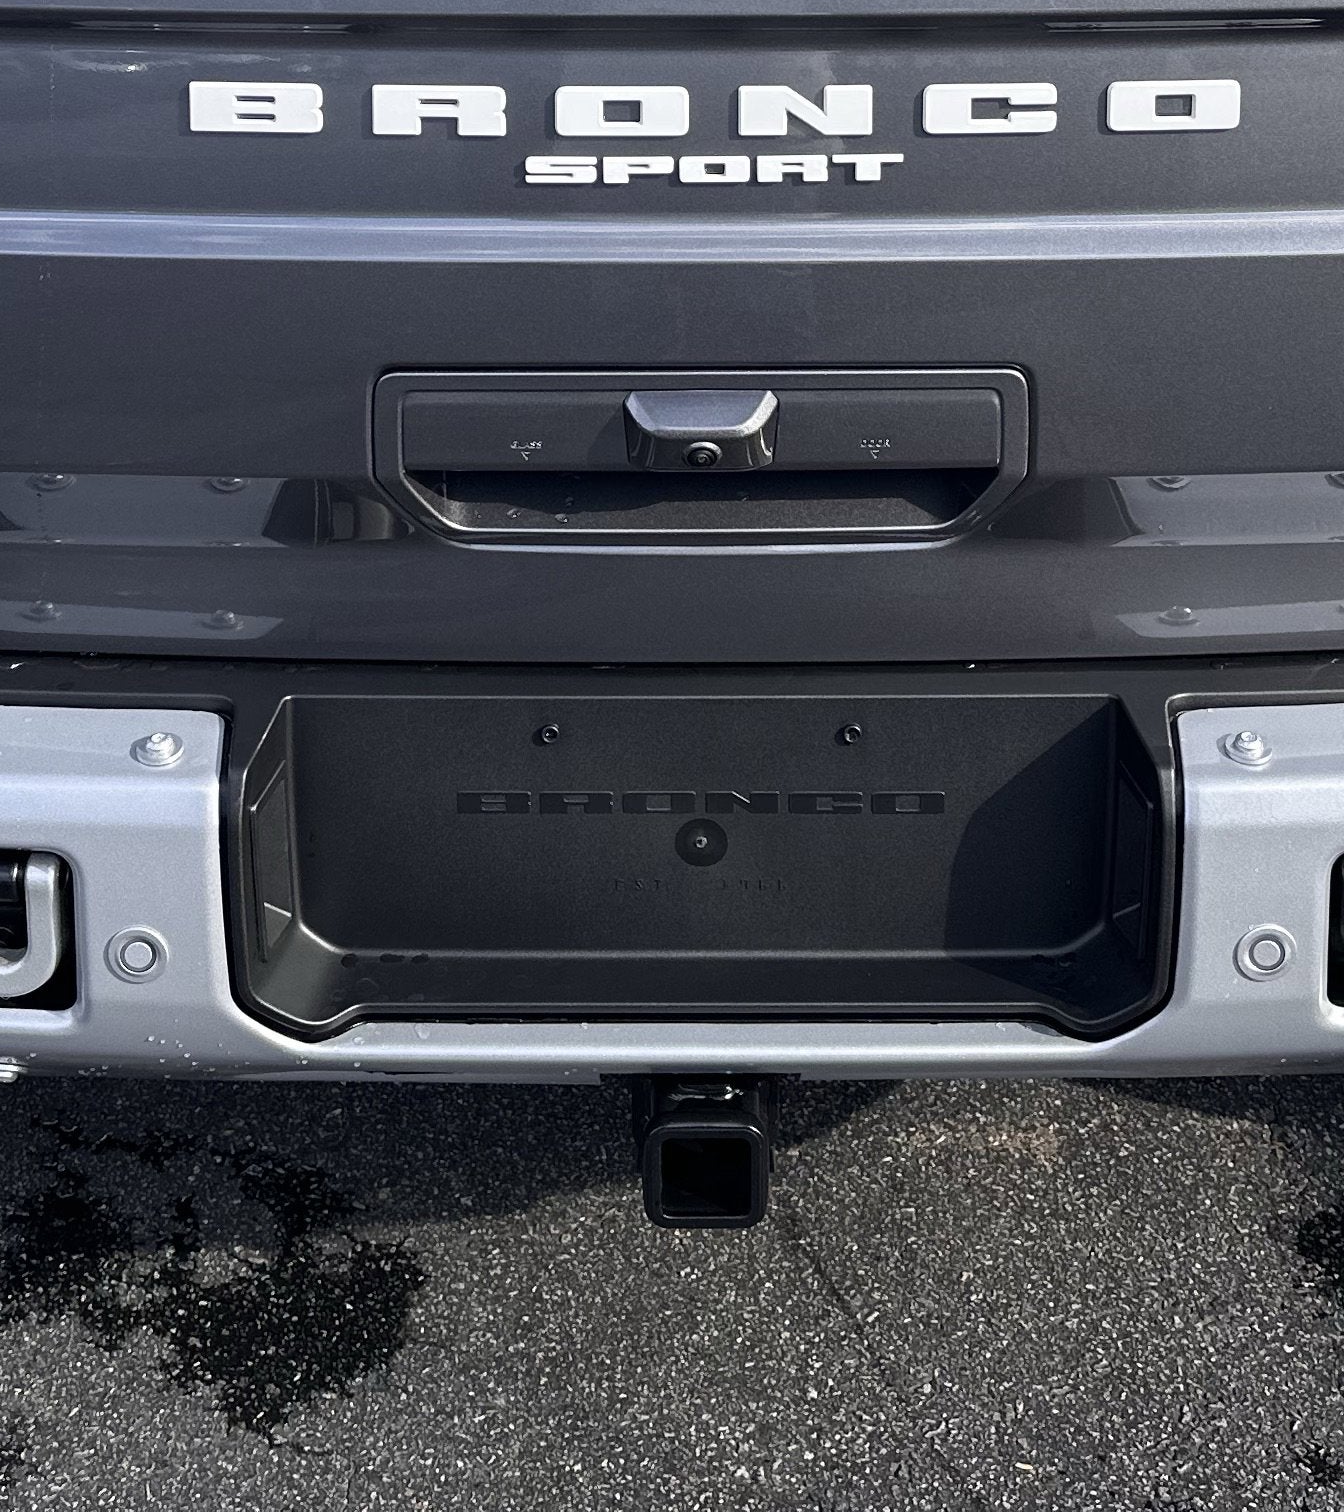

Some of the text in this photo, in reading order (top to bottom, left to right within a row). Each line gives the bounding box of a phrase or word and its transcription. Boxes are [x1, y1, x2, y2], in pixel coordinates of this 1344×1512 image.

[187, 79, 1242, 136] BRONCO
[524, 152, 904, 185] SPORT
[457, 791, 946, 815] BRONCO
